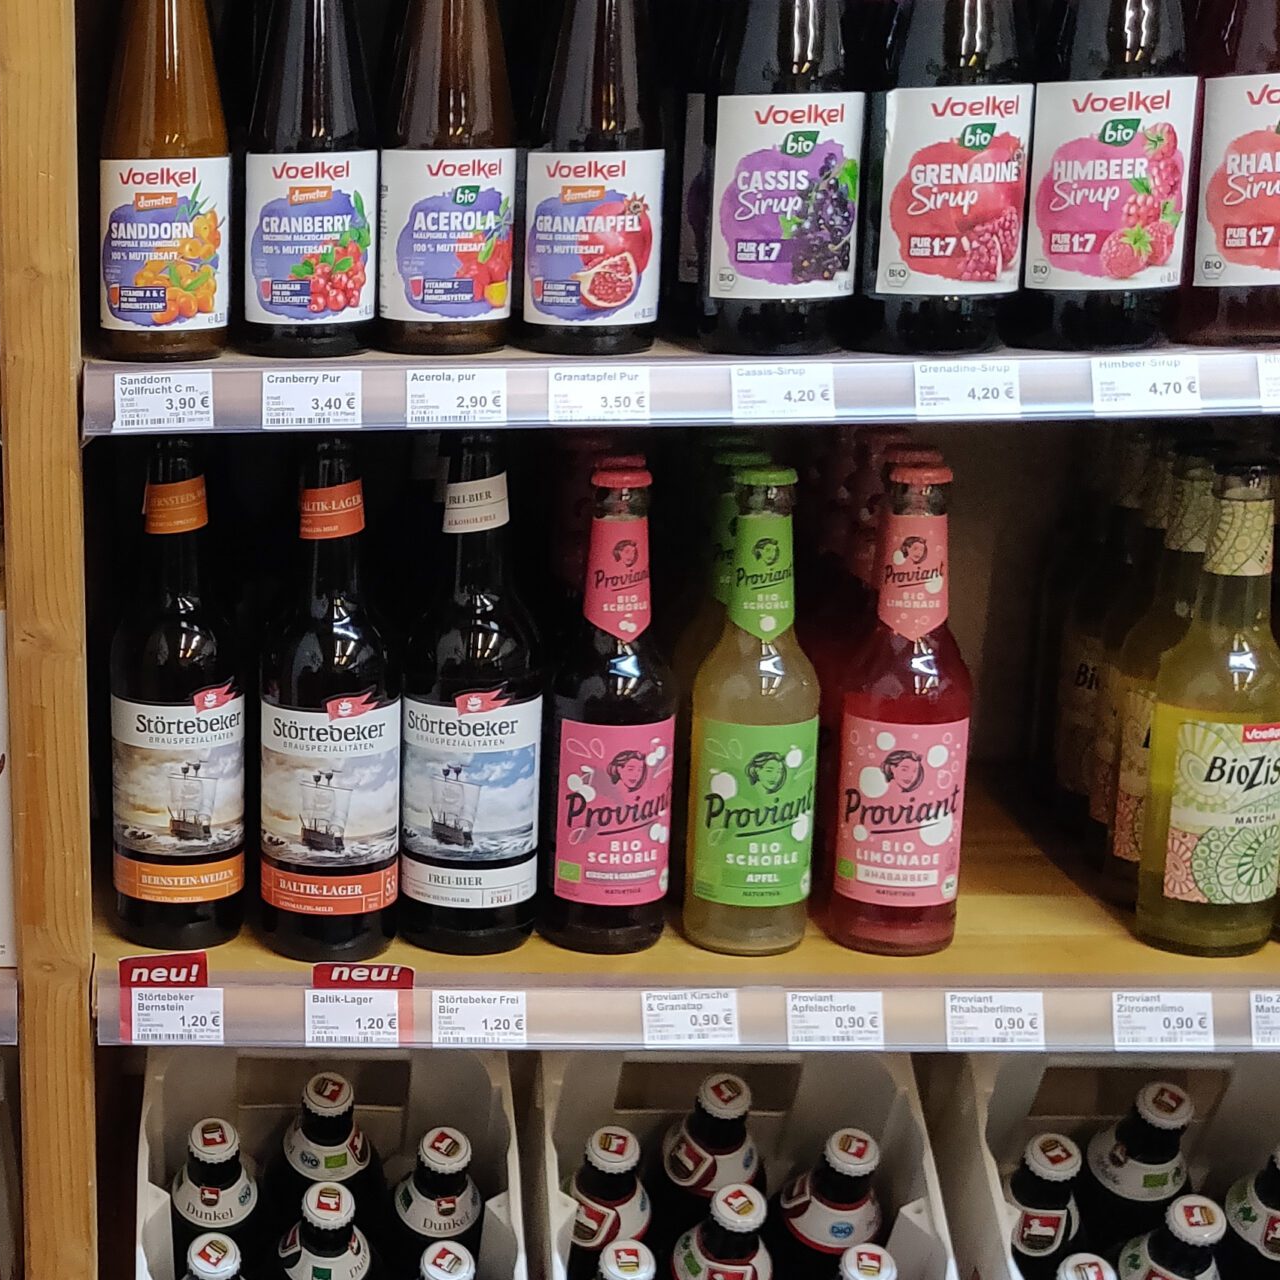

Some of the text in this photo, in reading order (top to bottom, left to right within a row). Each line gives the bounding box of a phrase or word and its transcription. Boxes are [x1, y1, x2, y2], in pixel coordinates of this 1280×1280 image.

[1072, 89, 1170, 114] Voelkel
[755, 104, 845, 126] Voelkel
[1104, 123, 1134, 141] bio
[786, 135, 814, 155] bio
[426, 159, 502, 179] Voelkel
[546, 160, 626, 180] Voelkel
[911, 161, 1018, 184] GRENADINE
[1053, 157, 1149, 180] HIMBEER
[120, 167, 196, 186] Voelkel
[736, 170, 810, 190] CASSIS
[138, 196, 173, 207] demeter
[292, 189, 328, 202] demeter
[455, 188, 476, 203] bio
[1049, 181, 1120, 212] Sirup
[735, 190, 802, 220] Sirup
[262, 214, 351, 233] CRANBERRY
[413, 211, 496, 230] ACEROLA
[536, 215, 641, 232] GRANATAPFEL
[111, 222, 194, 239] SANDDORN
[282, 245, 331, 254] MUTTERSAFT
[436, 243, 487, 252] MUTTERSAFT
[932, 237, 956, 256] 1:7
[1071, 233, 1096, 253] 1:7
[120, 376, 171, 385] Sanddorn
[267, 374, 340, 384] Cranberry Pur
[411, 372, 476, 383] Acerola, pur
[554, 372, 639, 382] Granatapfel Pur
[120, 386, 172, 395] Vollfrucht
[175, 384, 182, 392] C
[968, 388, 999, 401] 4,20
[1149, 382, 1181, 396] 4,70
[166, 396, 209, 410] 3,90 €
[456, 396, 501, 409] 2,90 €
[600, 396, 646, 409] 3,50 €
[784, 390, 814, 403] 4,20
[312, 398, 356, 410] 3,40 €
[273, 718, 385, 741] Störtebeker
[408, 709, 518, 737] Störtebeker
[283, 740, 374, 752] BRAUSPEZIALITÄTEN
[704, 787, 814, 829] Proviant
[845, 787, 960, 826] Proviant
[610, 841, 642, 851] BIO
[881, 841, 915, 853] BIO
[587, 848, 657, 864] SCHORLE
[856, 851, 940, 866] LIMONADE
[141, 869, 234, 886] BERNSTEIN-WEIZEN
[428, 873, 482, 886] FREI-BIER
[746, 874, 779, 883] APFEL
[864, 870, 929, 882] RHABARBER
[279, 878, 362, 896] BALTIK-LAGER
[131, 964, 199, 982] neu!
[138, 993, 194, 1001] Störtebeker
[312, 995, 372, 1005] Baltik-Lager
[438, 995, 518, 1005] Störtebeker Frei
[646, 991, 729, 1001] Proviant Kirsche
[792, 994, 833, 1002] Proviant
[950, 995, 993, 1003] Proviant
[1117, 994, 1160, 1003] Proviant
[138, 1003, 184, 1011] Bernstein
[439, 1005, 459, 1014] Bier
[646, 1001, 702, 1013] & Granatap
[792, 1002, 856, 1013] Apfelschorle
[1117, 1004, 1184, 1013] Zitronenlimo
[180, 1016, 220, 1027] 1,20 €
[355, 1017, 397, 1030] 1,20 €
[482, 1018, 523, 1031] 1,20 €
[690, 1013, 719, 1027] 0,90
[835, 1016, 864, 1029] 0,90
[994, 1018, 1024, 1031] 0,90
[1163, 1017, 1193, 1030] 0,90
[185, 1203, 233, 1222] Dunkel
